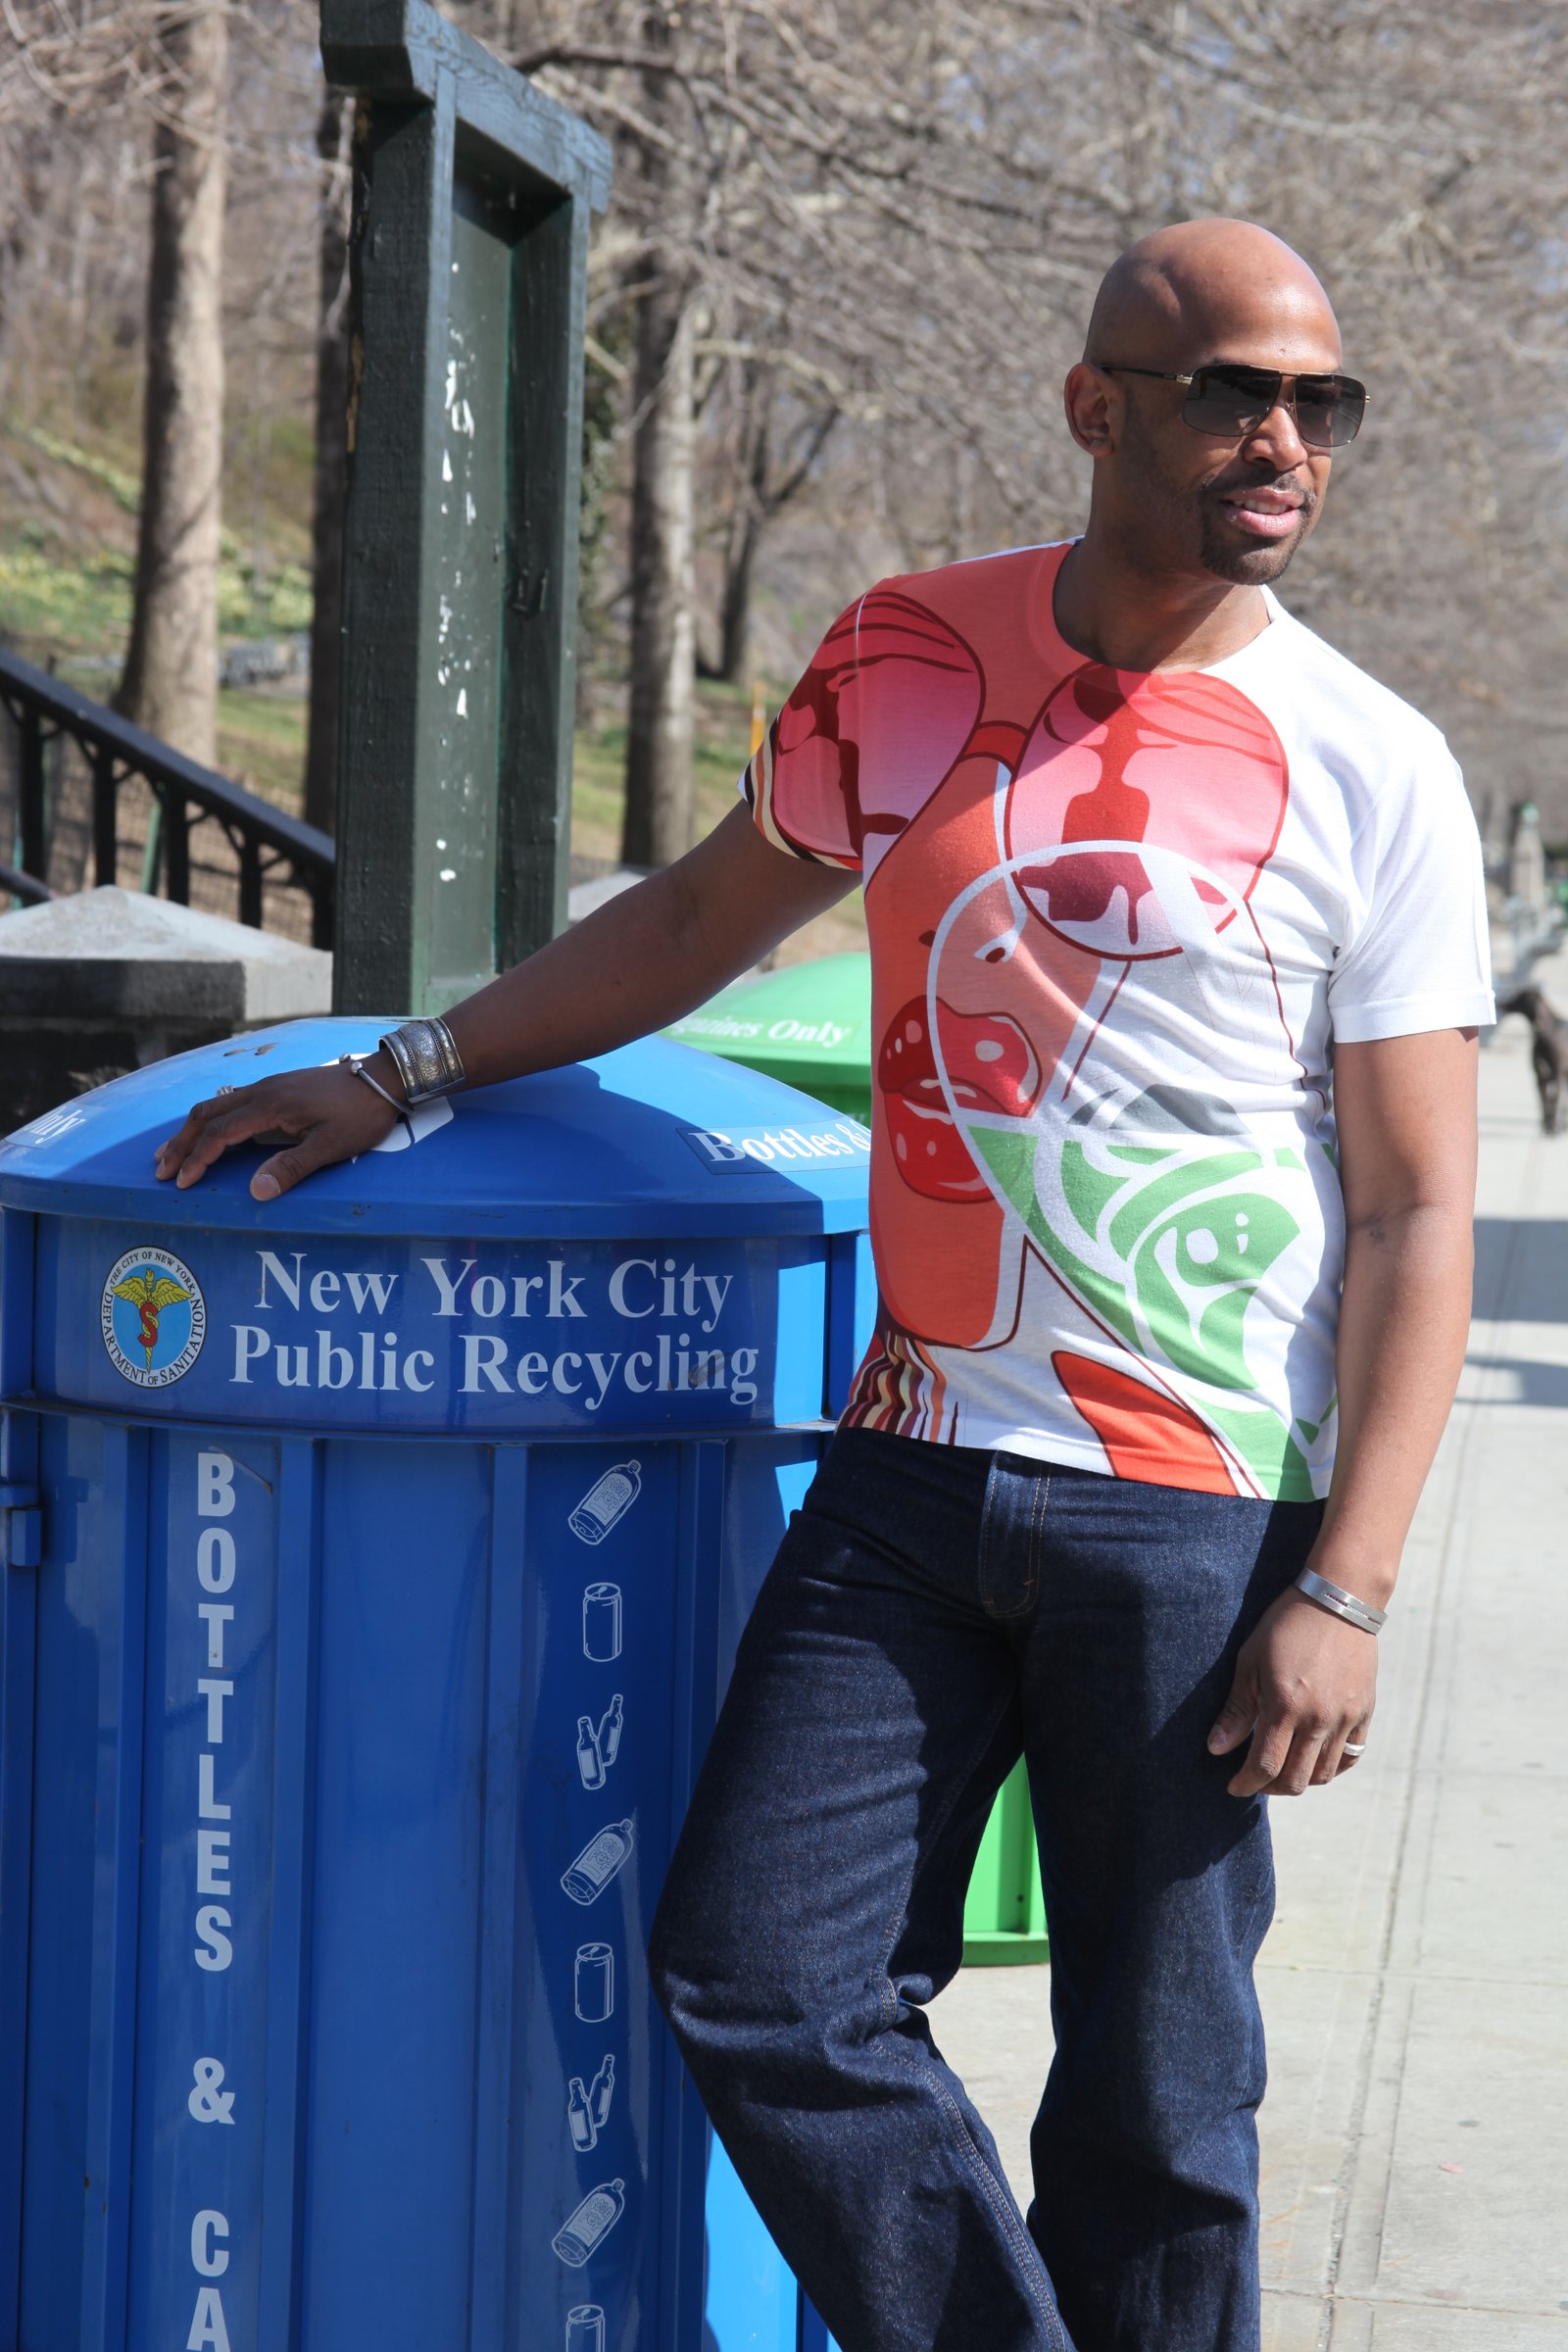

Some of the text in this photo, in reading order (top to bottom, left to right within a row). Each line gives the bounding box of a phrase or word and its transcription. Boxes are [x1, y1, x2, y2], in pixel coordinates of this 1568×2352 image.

[767, 1018, 853, 1048] Only
[688, 1128, 854, 1162] Bottles
[835, 1123, 871, 1152] &
[110, 1250, 196, 1292] THE CITY OF NEW YORK
[254, 1250, 734, 1333] New York City
[102, 1292, 205, 1386] DEPARTMENT OF SANITATION
[228, 1324, 760, 1411] Public Recycling
[594, 1490, 620, 1511] POP
[186, 1450, 236, 2352] BOTTLES & CA
